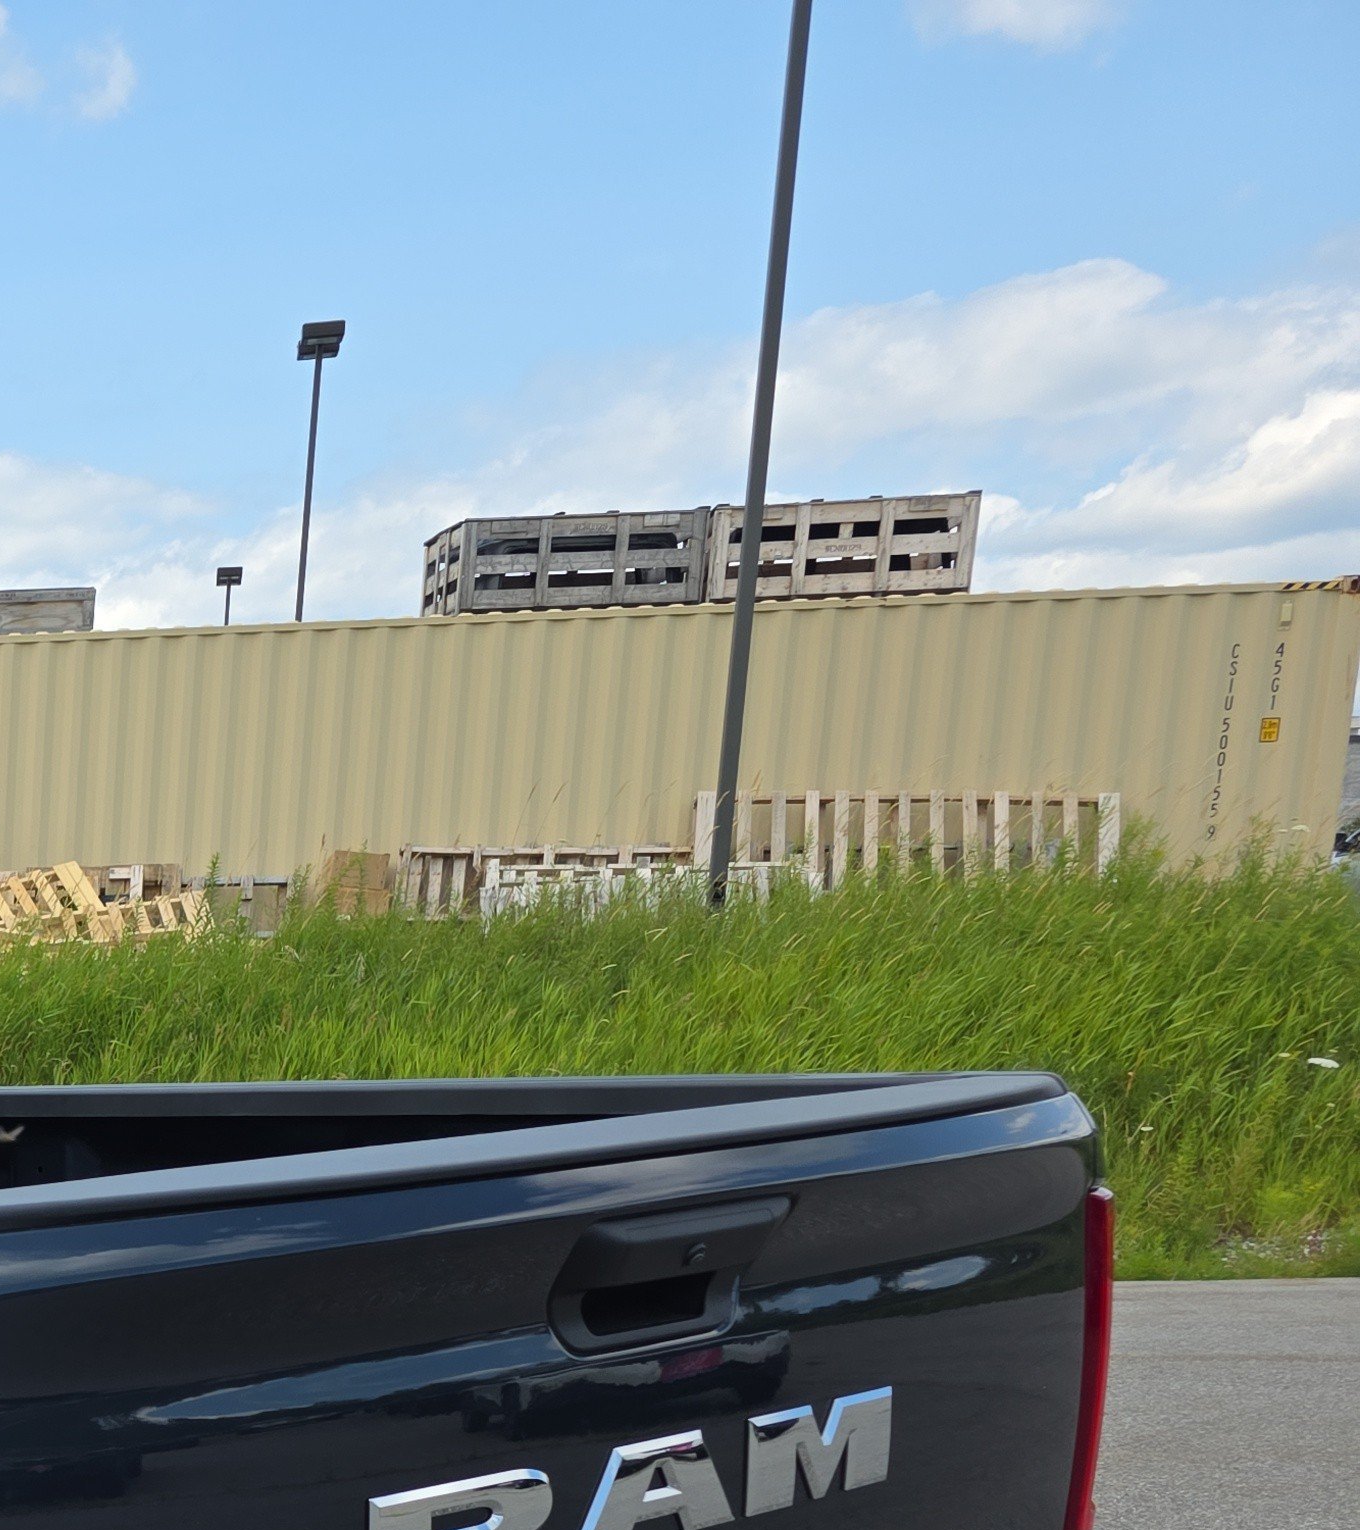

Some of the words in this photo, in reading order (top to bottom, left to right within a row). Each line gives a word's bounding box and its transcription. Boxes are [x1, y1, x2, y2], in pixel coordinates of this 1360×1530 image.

[1224, 643, 1241, 711] CSIU
[1270, 642, 1285, 710] 45G1
[1210, 717, 1231, 818] 500155
